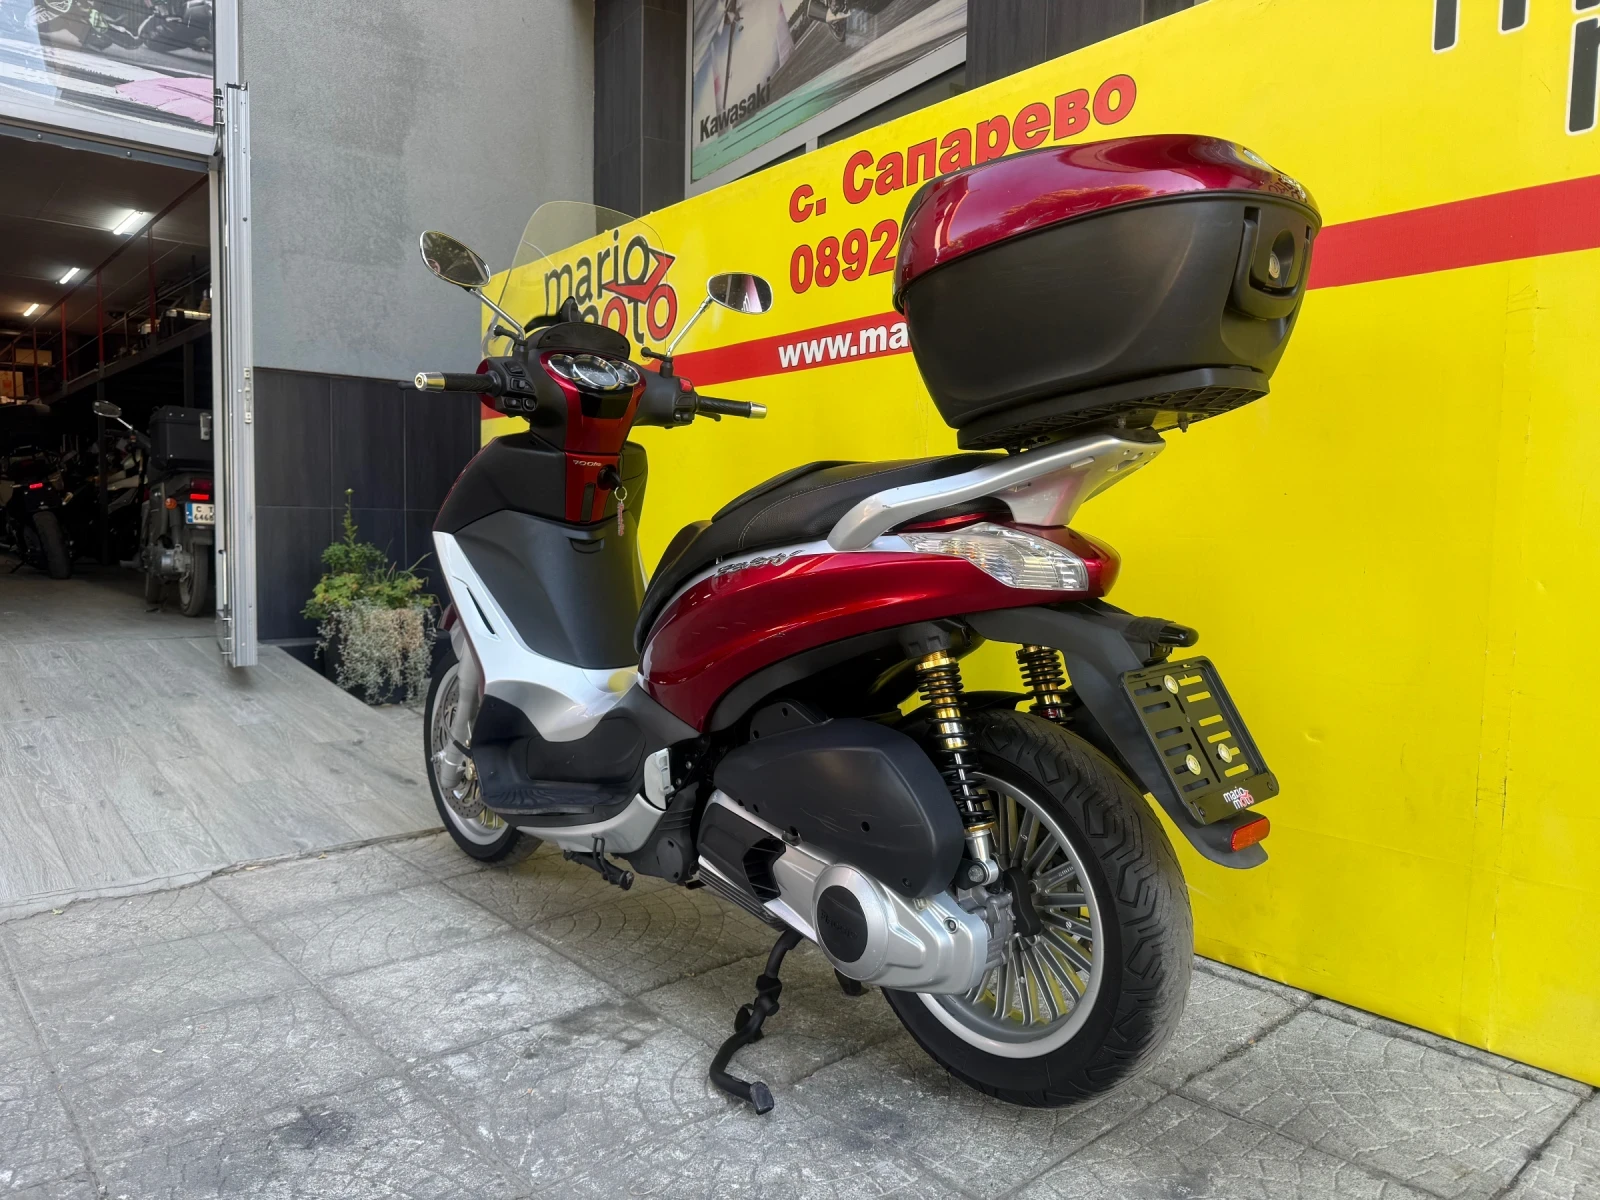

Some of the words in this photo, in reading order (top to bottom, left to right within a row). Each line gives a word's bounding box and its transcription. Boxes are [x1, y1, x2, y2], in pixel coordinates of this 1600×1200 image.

[700, 76, 771, 142] Kawasaki
[843, 74, 1137, 205] Сапарево
[544, 229, 650, 316] mario
[790, 219, 899, 294] 0892
[1223, 786, 1246, 803] mario
[1233, 794, 1254, 810] moto
